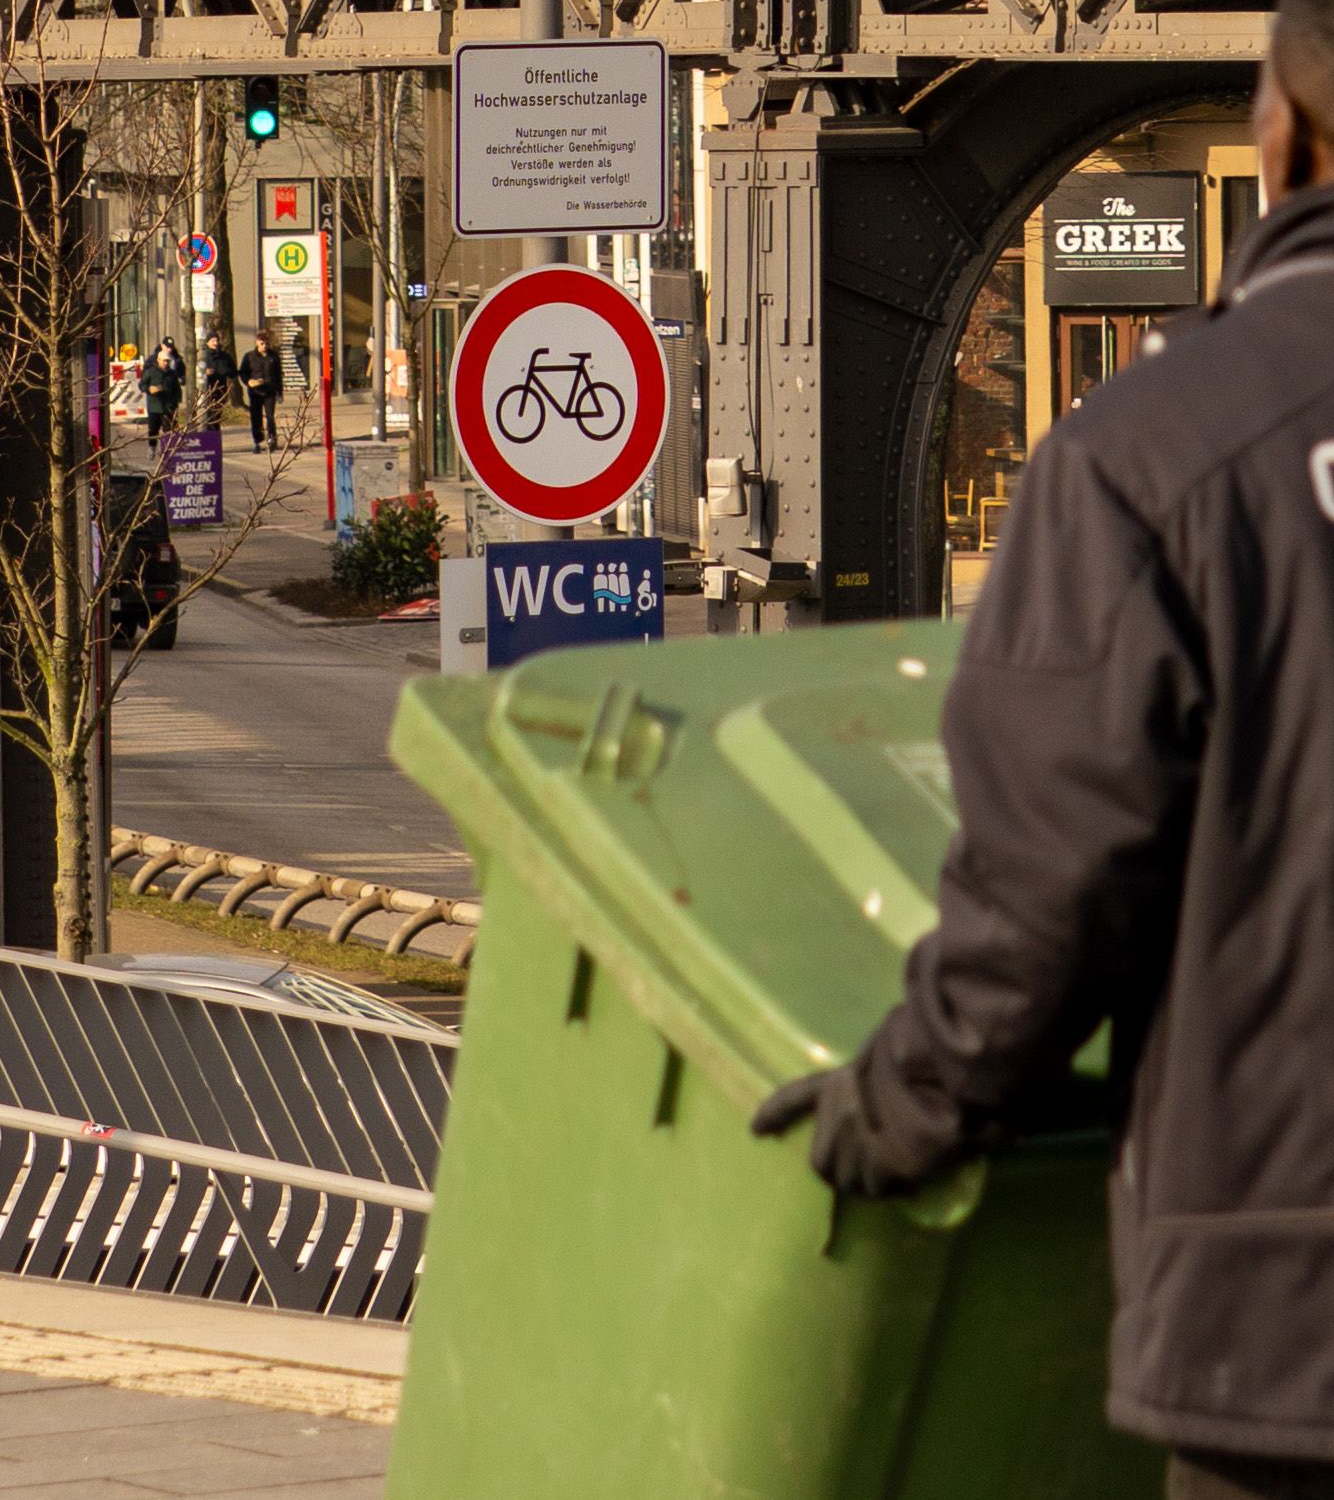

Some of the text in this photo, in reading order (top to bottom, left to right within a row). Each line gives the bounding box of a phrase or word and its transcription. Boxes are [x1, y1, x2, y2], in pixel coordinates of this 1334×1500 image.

[524, 66, 599, 85] Öffentliche
[474, 89, 648, 108] Hochwasserschutzanlage
[516, 125, 607, 139] Nutzungen nur mit
[485, 140, 636, 155] deichrechtlicher Genehmigung!
[511, 157, 612, 170] Verstöße werden als
[492, 173, 631, 188] Ordnungswidrigkeit verfolgt!
[566, 199, 648, 211] Die Wasserbehörde
[1102, 197, 1136, 216] The
[1055, 224, 1186, 253] GREEK
[284, 248, 299, 267] H
[186, 484, 204, 495] DIE
[169, 495, 219, 507] ZUKUNFT
[836, 572, 869, 587] 24/23
[493, 563, 586, 617] WC
